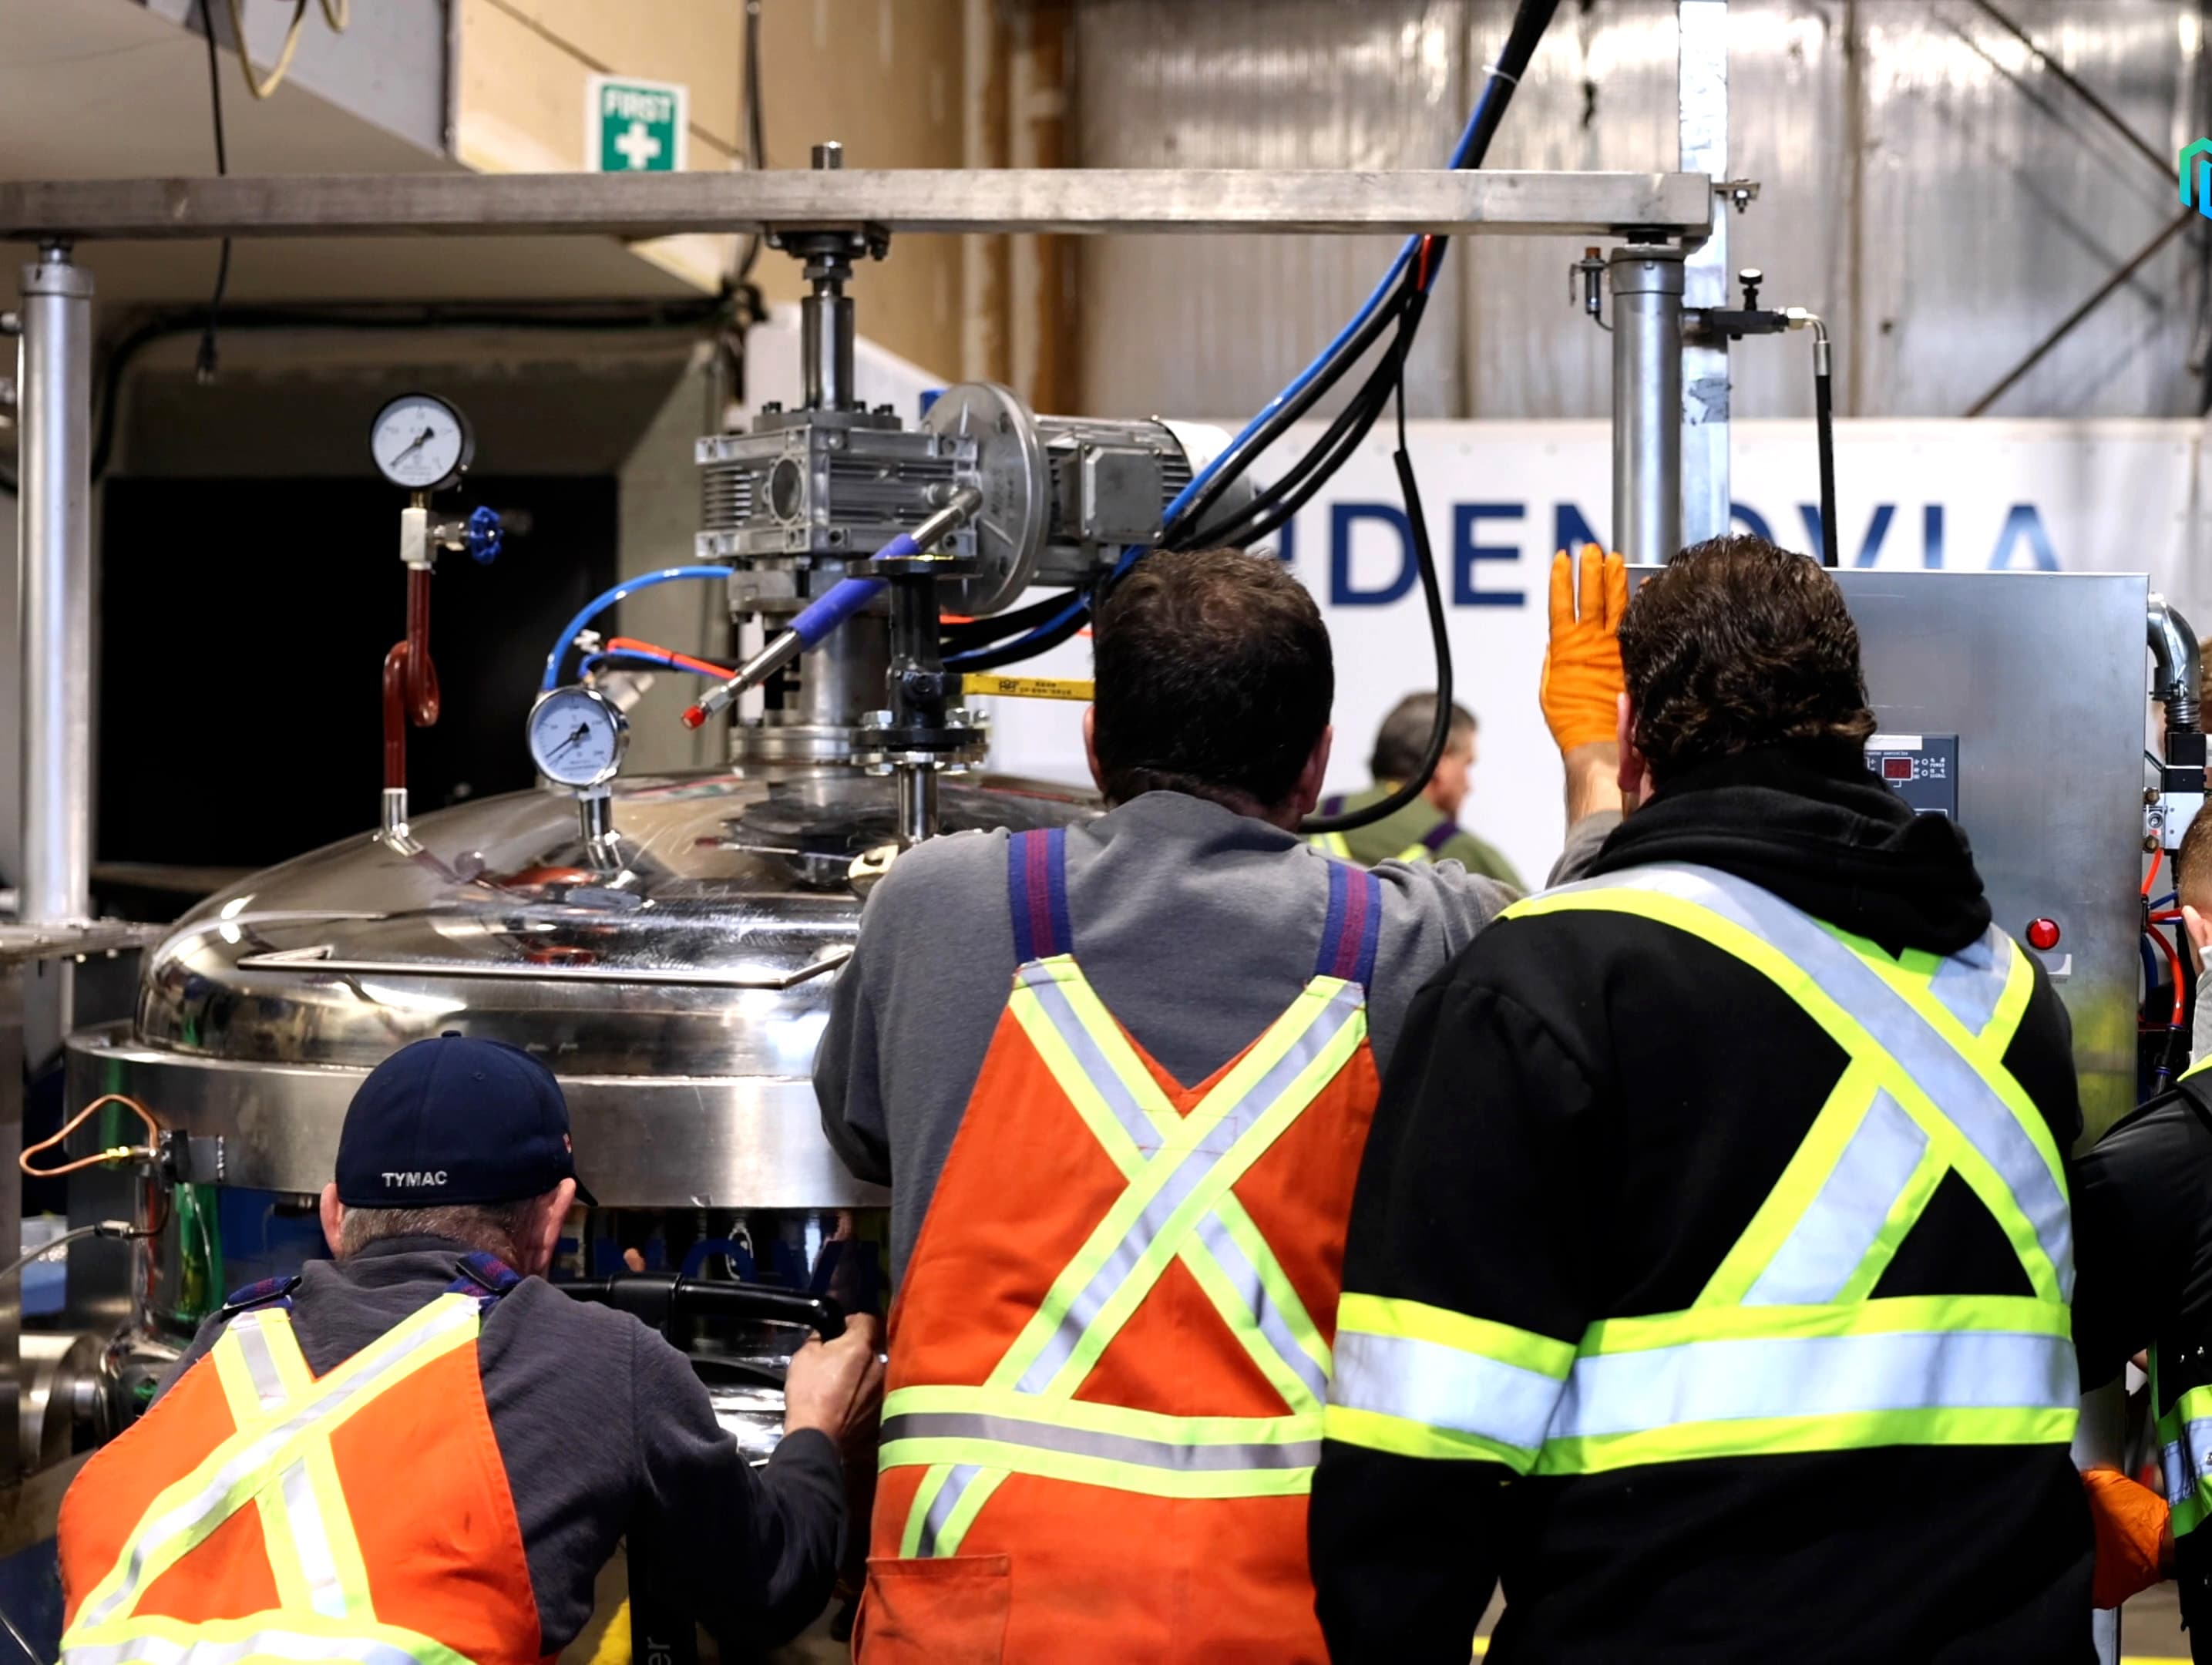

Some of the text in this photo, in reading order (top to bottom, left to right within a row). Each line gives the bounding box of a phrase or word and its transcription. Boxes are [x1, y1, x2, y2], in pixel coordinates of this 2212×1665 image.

[606, 91, 670, 122] FIRST
[1330, 503, 2060, 606] DEVIA
[382, 1170, 448, 1187] TYMAC
